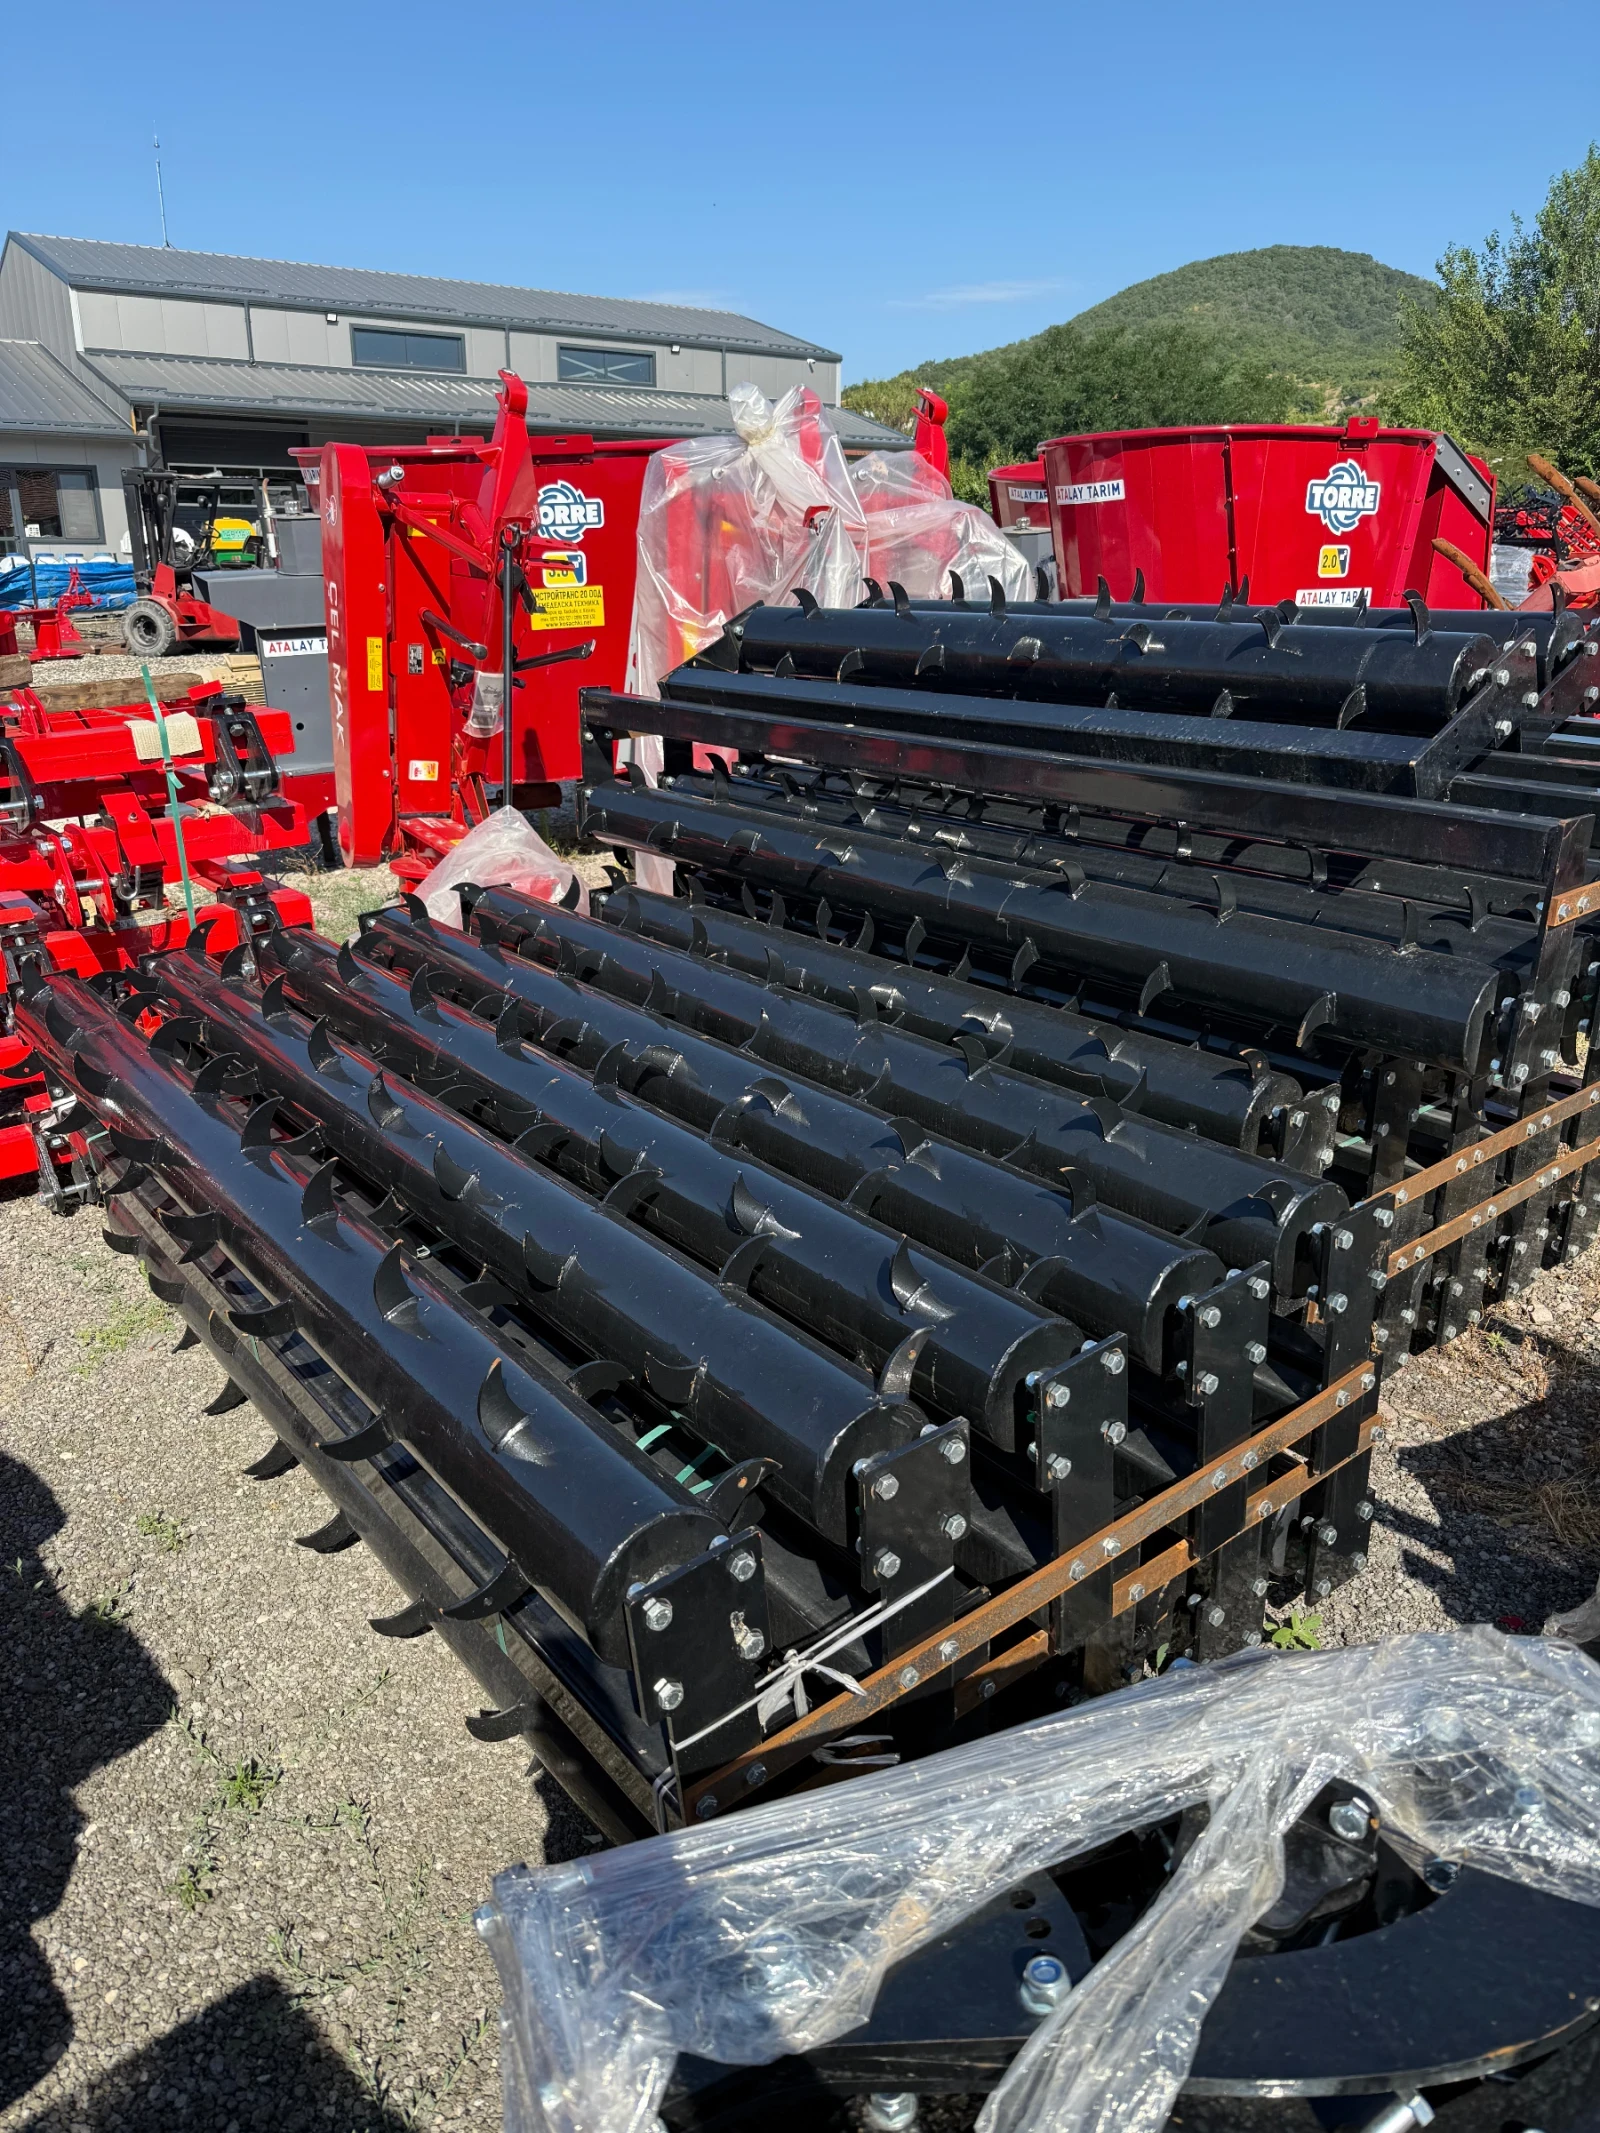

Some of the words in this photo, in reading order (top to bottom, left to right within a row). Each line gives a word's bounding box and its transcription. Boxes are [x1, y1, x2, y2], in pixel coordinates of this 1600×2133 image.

[1011, 488, 1032, 500] ATALAY
[1057, 486, 1083, 500] ATALAY
[1087, 482, 1120, 499] TARIM
[1312, 486, 1375, 509] TORRE
[539, 504, 599, 525] ORRE
[1322, 554, 1338, 568] 2.0
[1300, 590, 1337, 605] ATALAY
[268, 640, 313, 654] ATALAY
[333, 662, 345, 748] MAK
